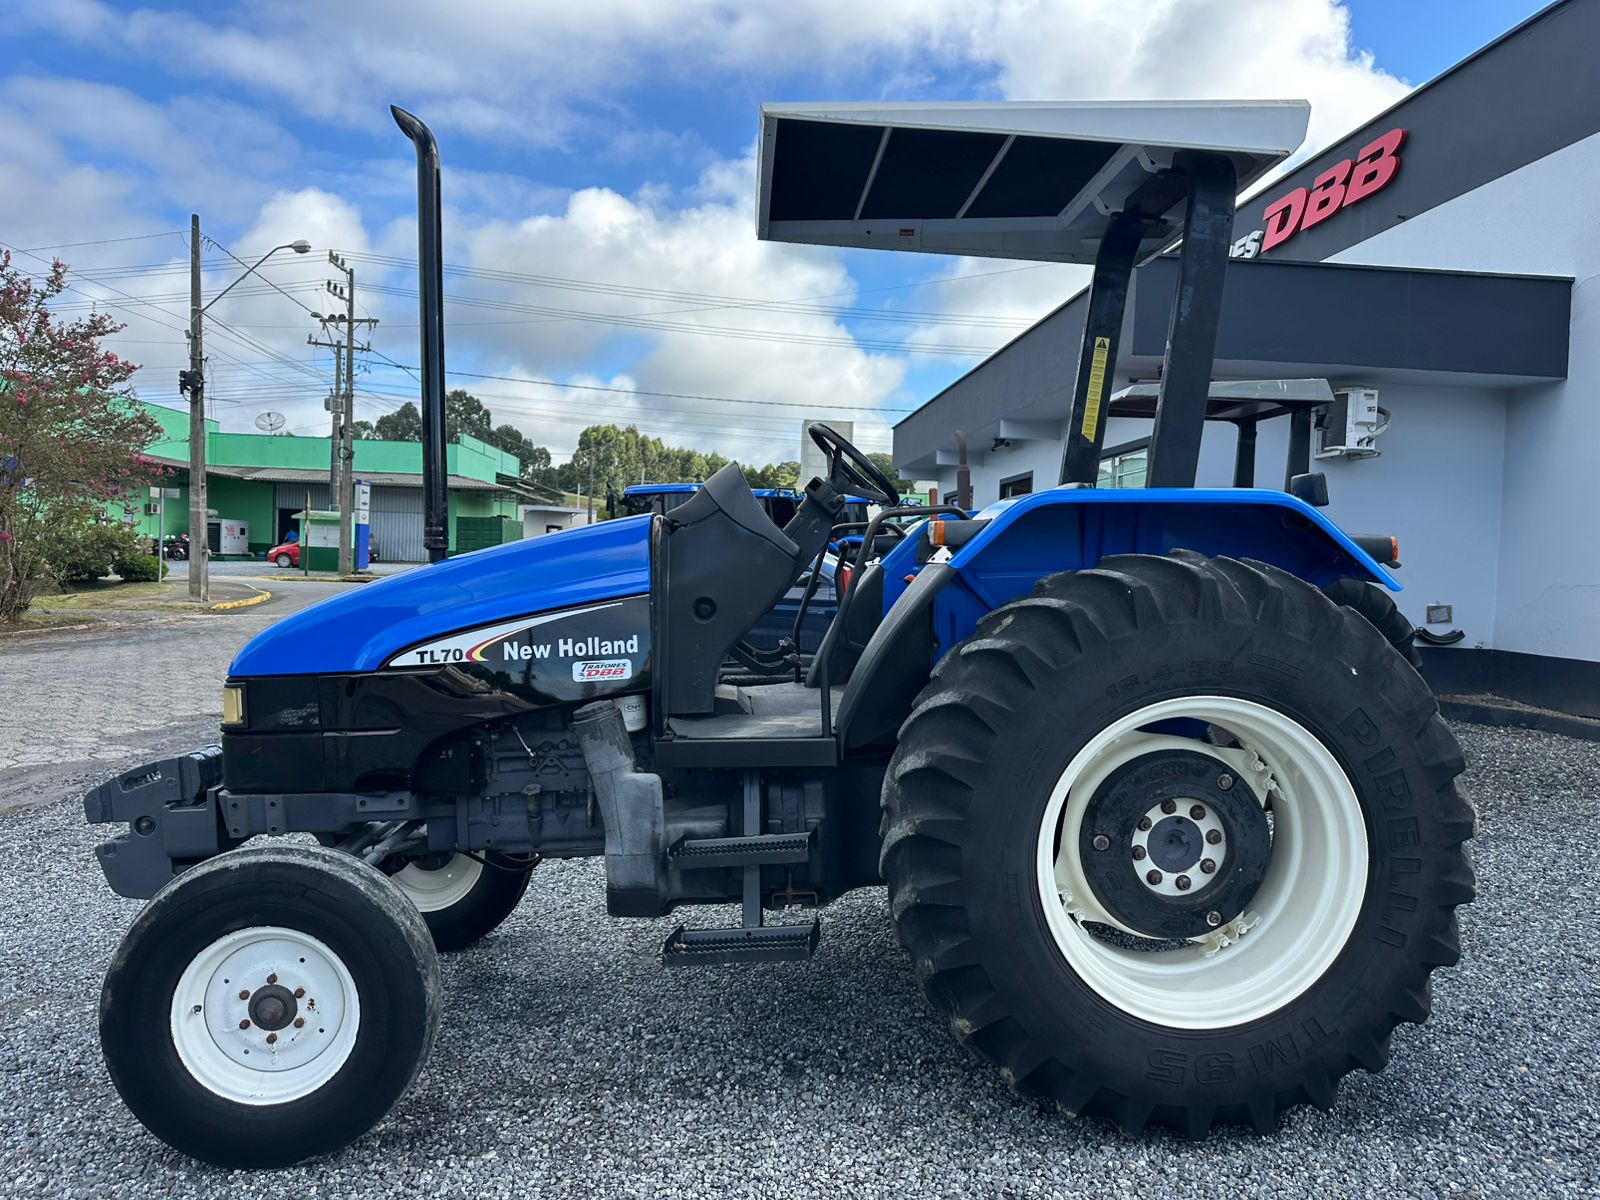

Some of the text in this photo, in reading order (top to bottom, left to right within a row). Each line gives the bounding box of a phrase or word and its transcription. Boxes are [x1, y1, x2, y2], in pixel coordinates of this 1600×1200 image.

[1261, 128, 1408, 254] DBB
[416, 648, 464, 664] TL70
[503, 634, 639, 661] New Holland
[581, 662, 627, 672] TRATORES
[586, 668, 625, 677] DBB
[1336, 706, 1422, 949] PIRELLI
